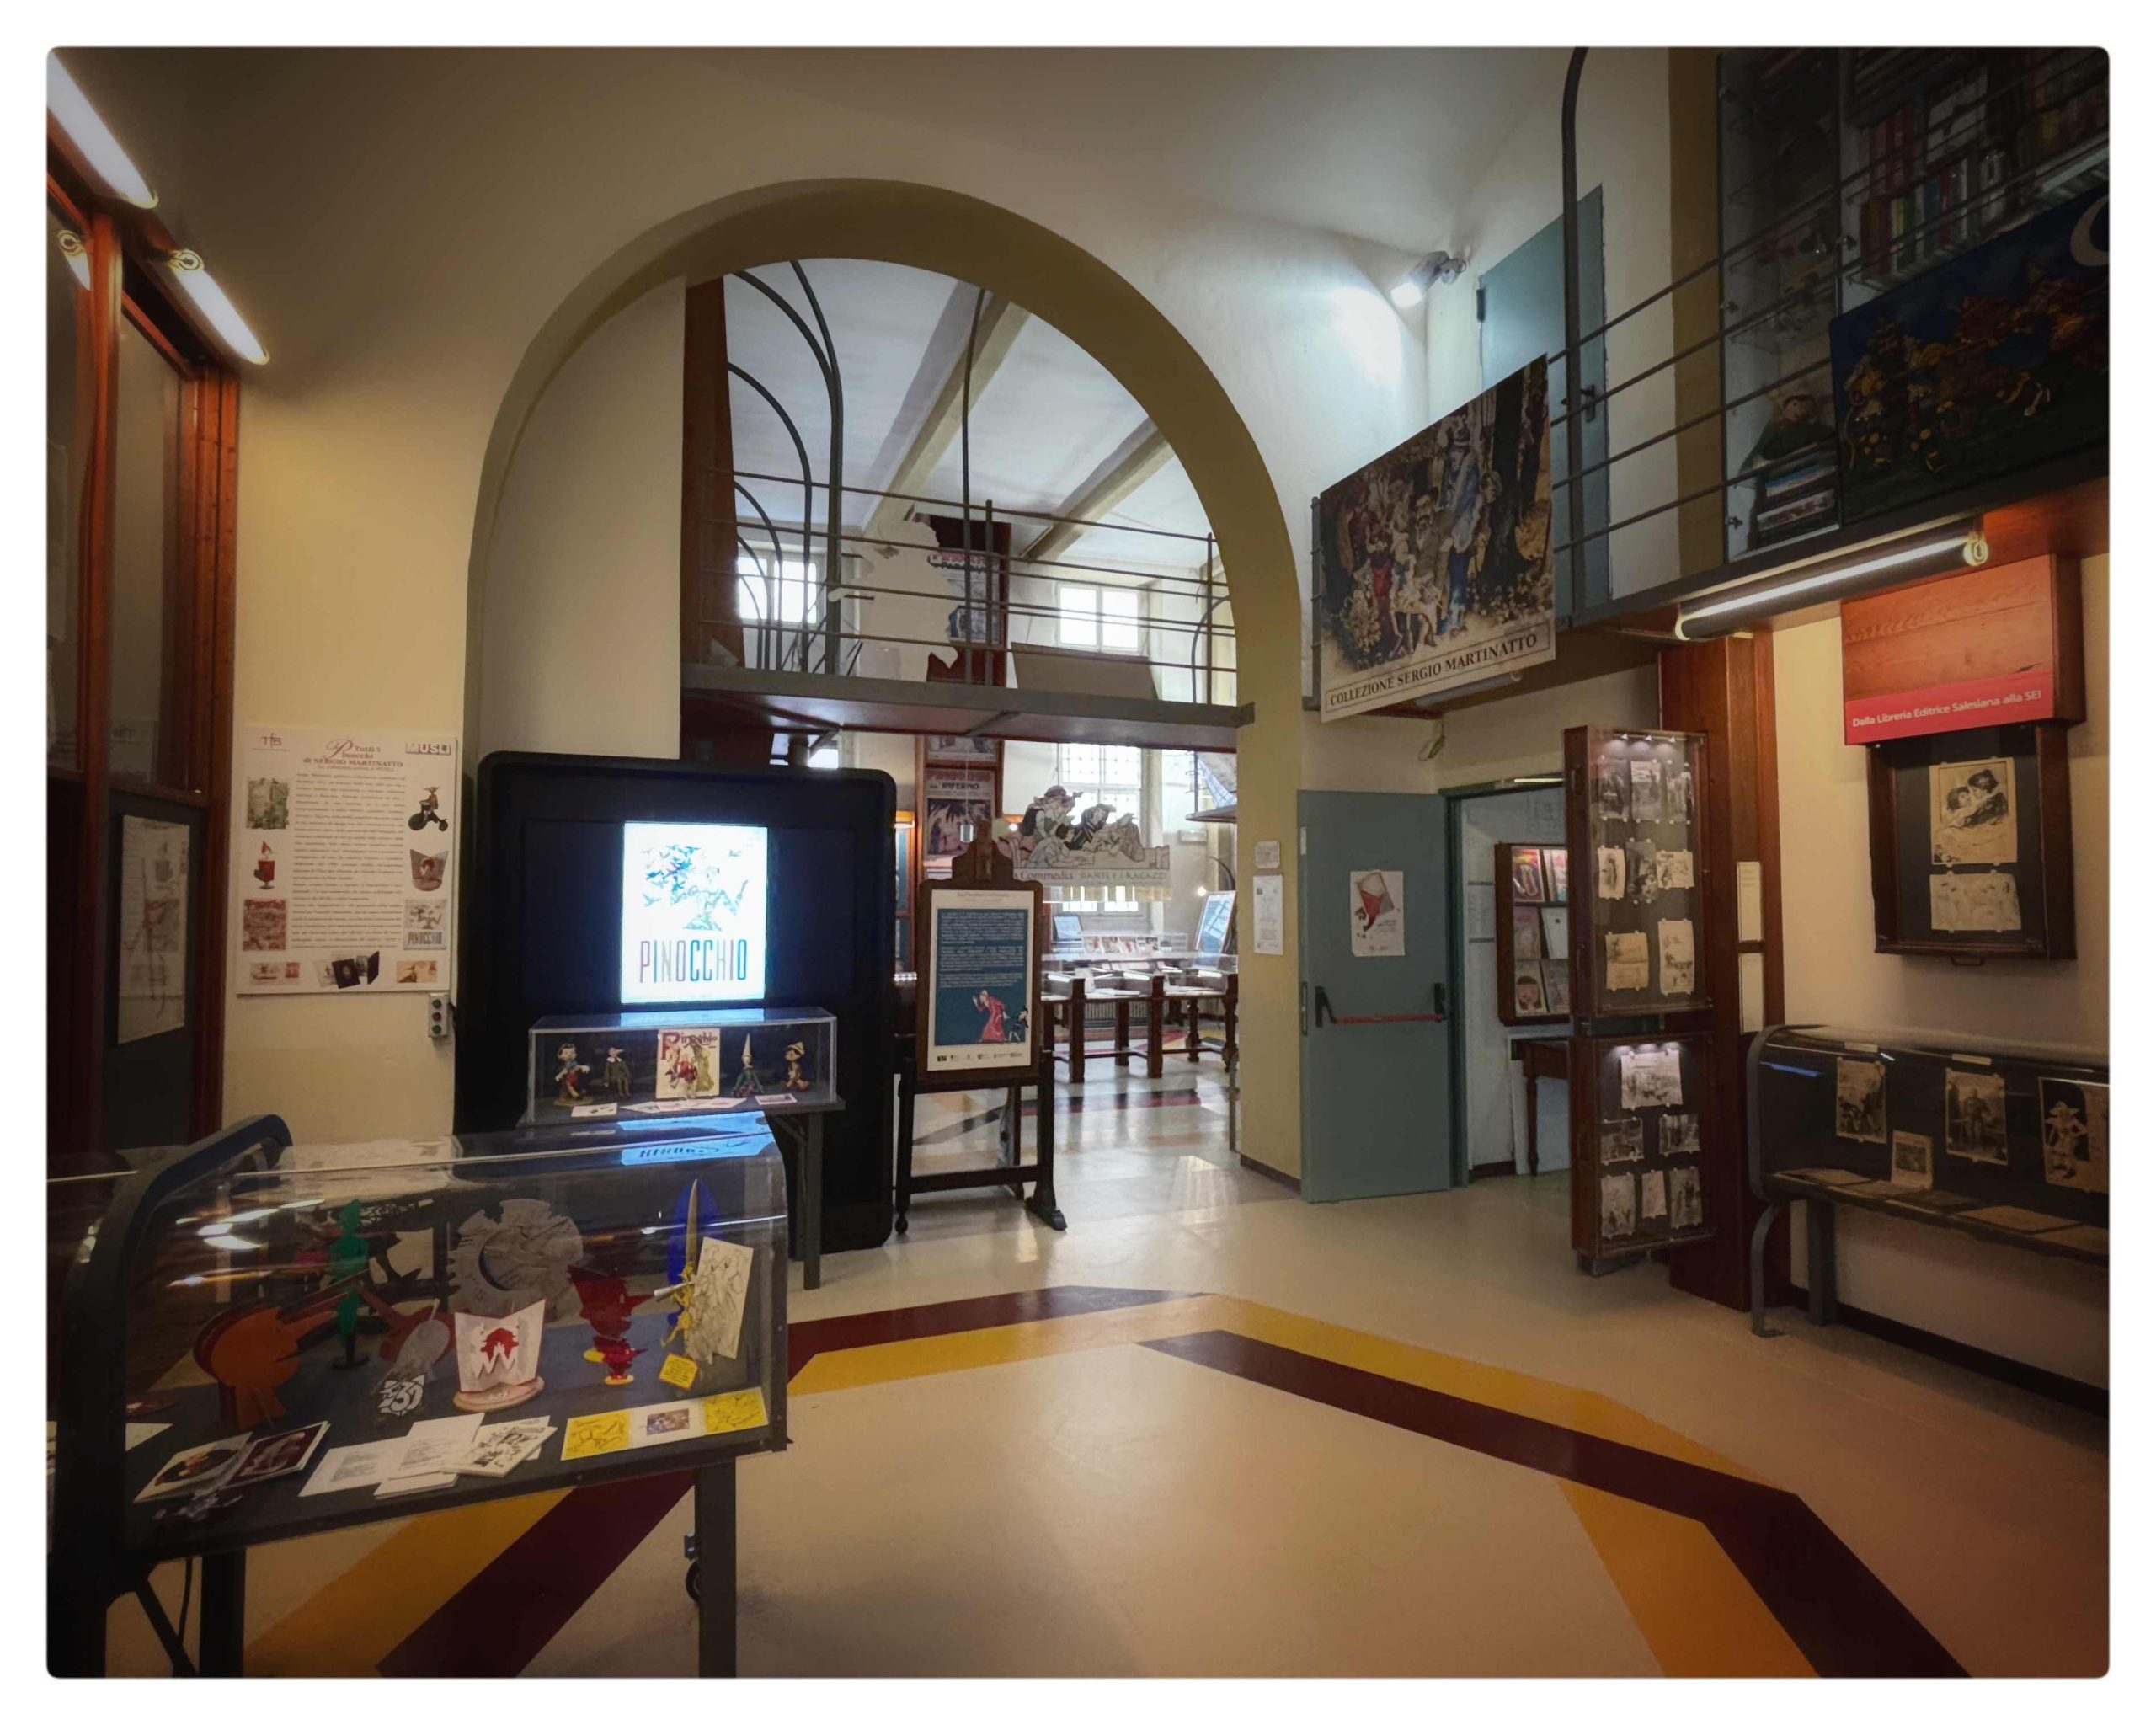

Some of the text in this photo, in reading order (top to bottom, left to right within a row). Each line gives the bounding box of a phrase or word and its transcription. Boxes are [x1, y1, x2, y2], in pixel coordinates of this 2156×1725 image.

[1330, 633, 1537, 706] COLLEZIONE SERGIO MARTINATTO
[1852, 690, 2042, 728] Dalla Libreria Editrice Salesiana alla SEI
[349, 760, 403, 768] MARTINATTO
[640, 939, 747, 984] PINOCCHIO
